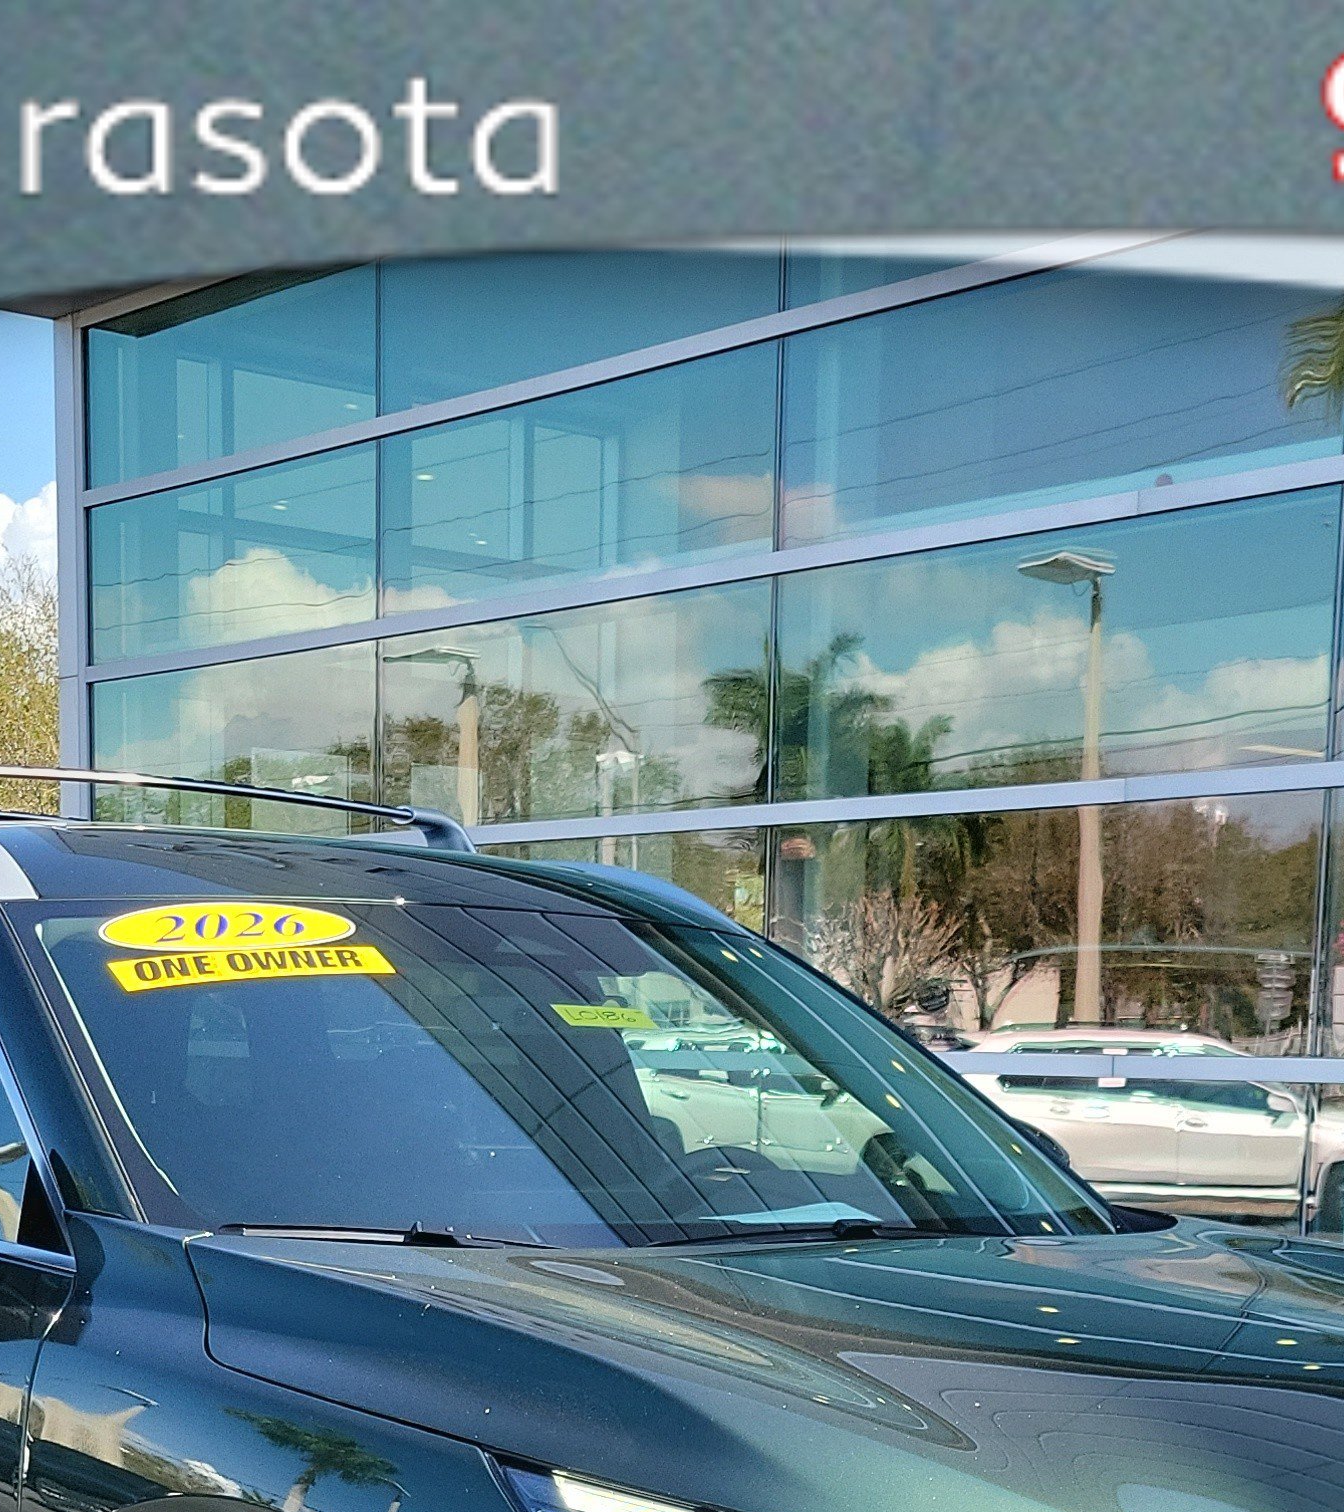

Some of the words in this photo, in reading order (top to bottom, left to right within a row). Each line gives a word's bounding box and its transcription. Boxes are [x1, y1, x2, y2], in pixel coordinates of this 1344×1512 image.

[154, 912, 305, 943] 2026
[133, 955, 216, 982] ONE
[226, 949, 364, 973] OWNER
